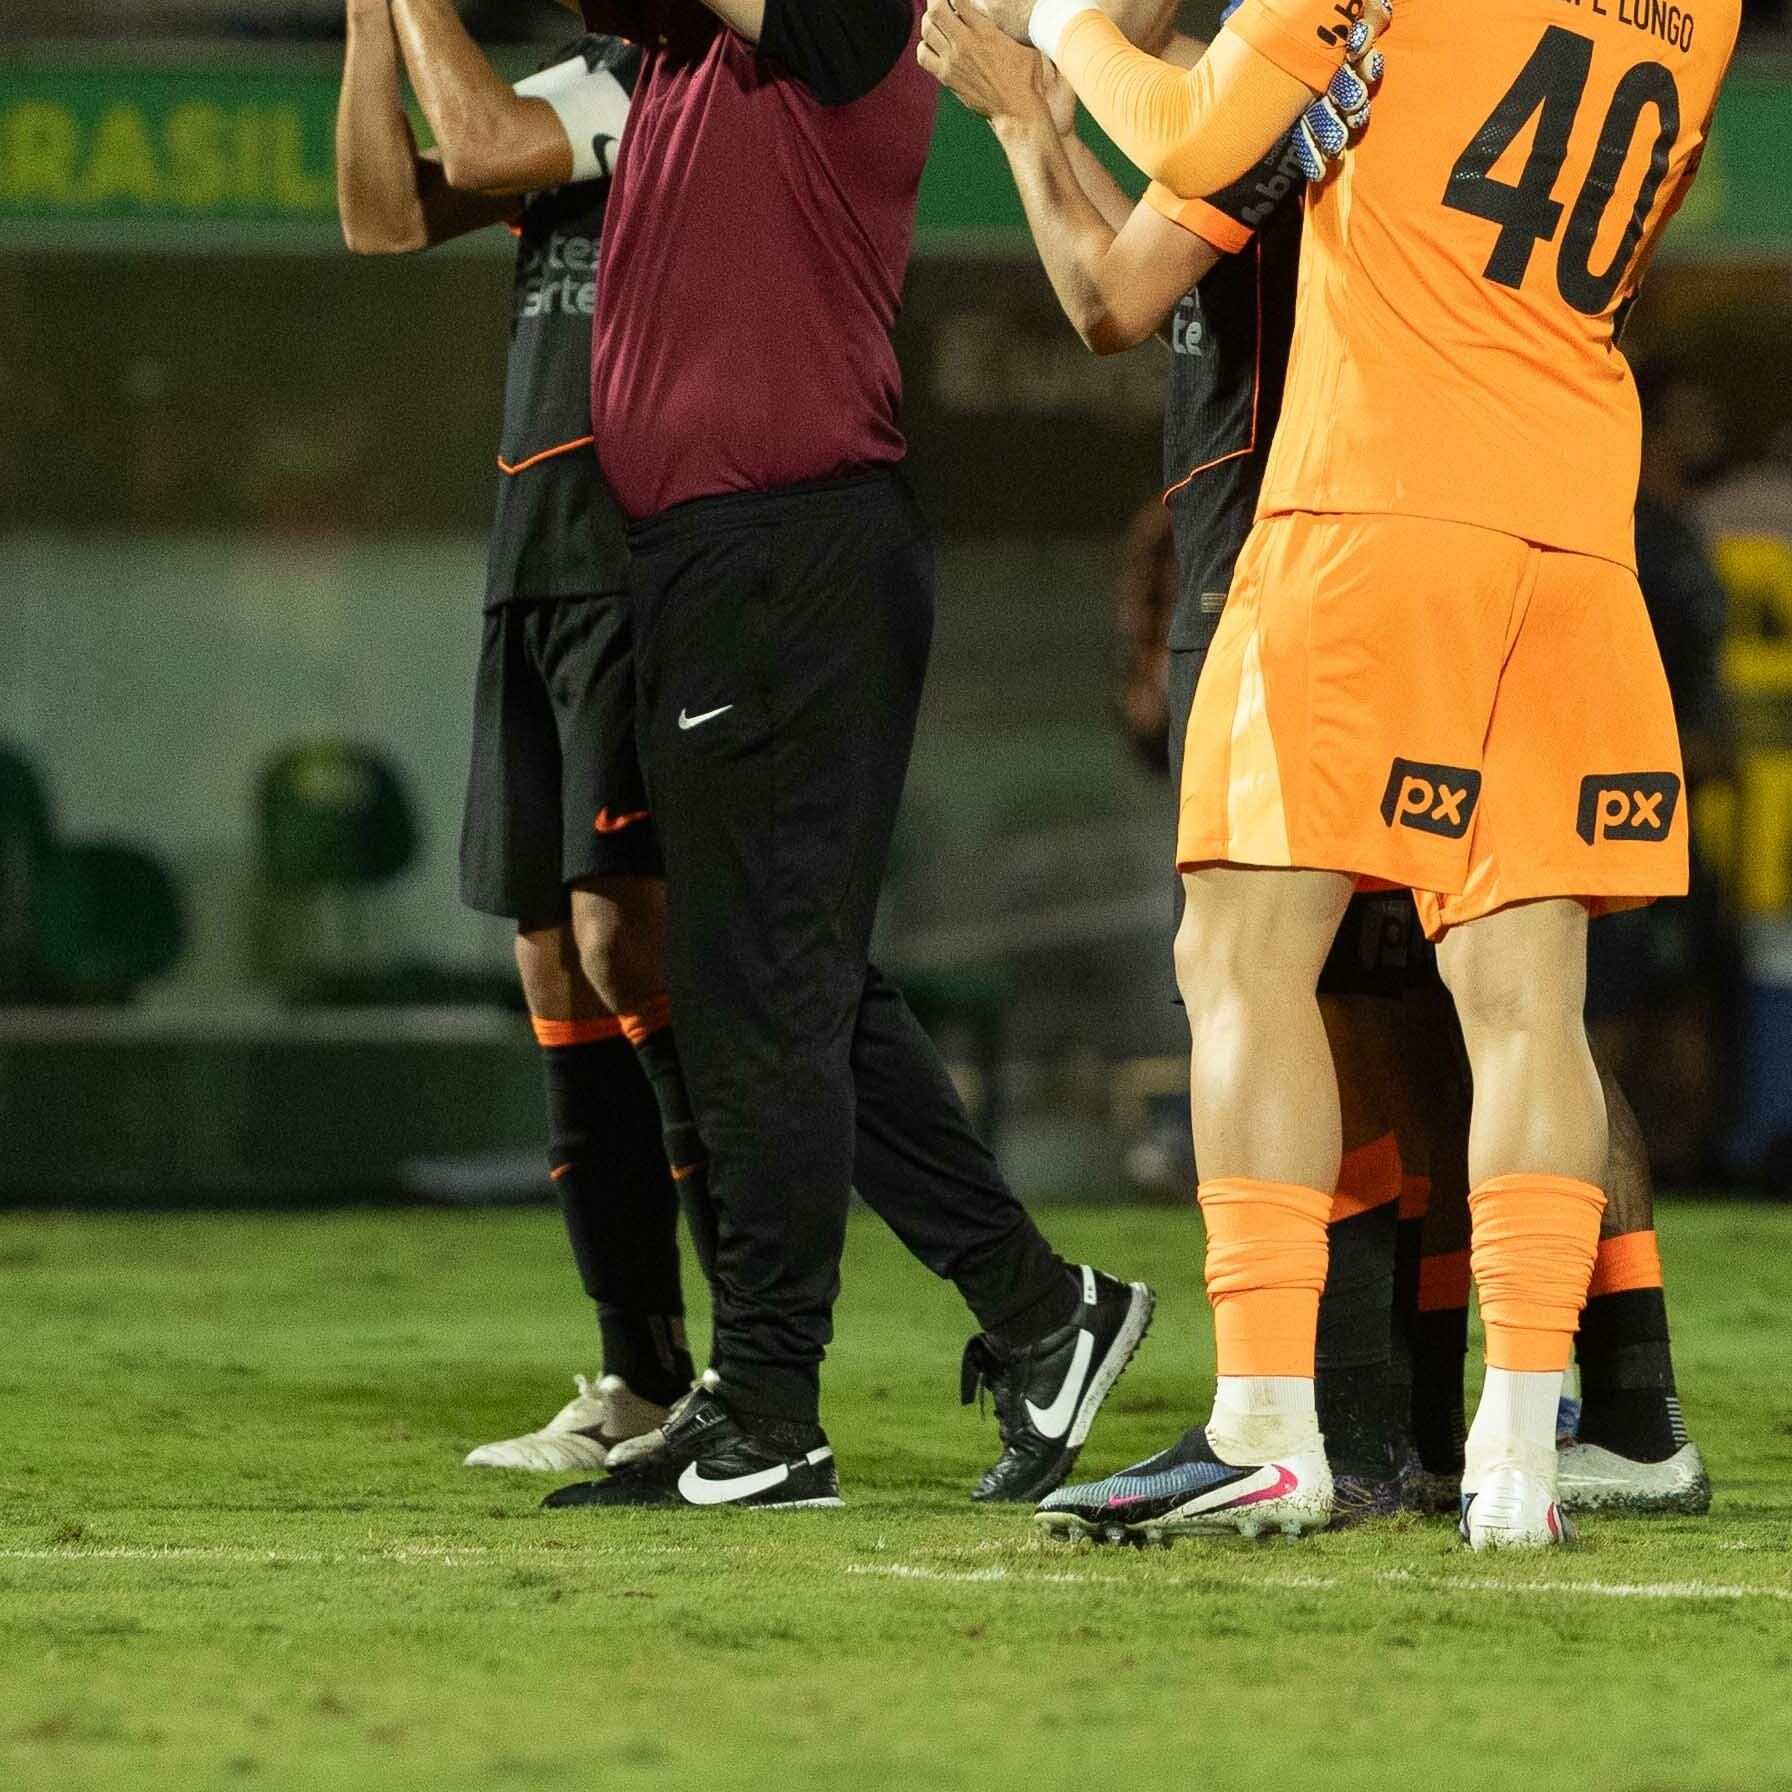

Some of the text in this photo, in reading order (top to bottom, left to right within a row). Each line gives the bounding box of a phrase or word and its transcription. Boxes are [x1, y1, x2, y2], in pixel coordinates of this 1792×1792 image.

[1441, 24, 1681, 316] 40
[1390, 775, 1468, 828] px
[1593, 789, 1664, 845] px
